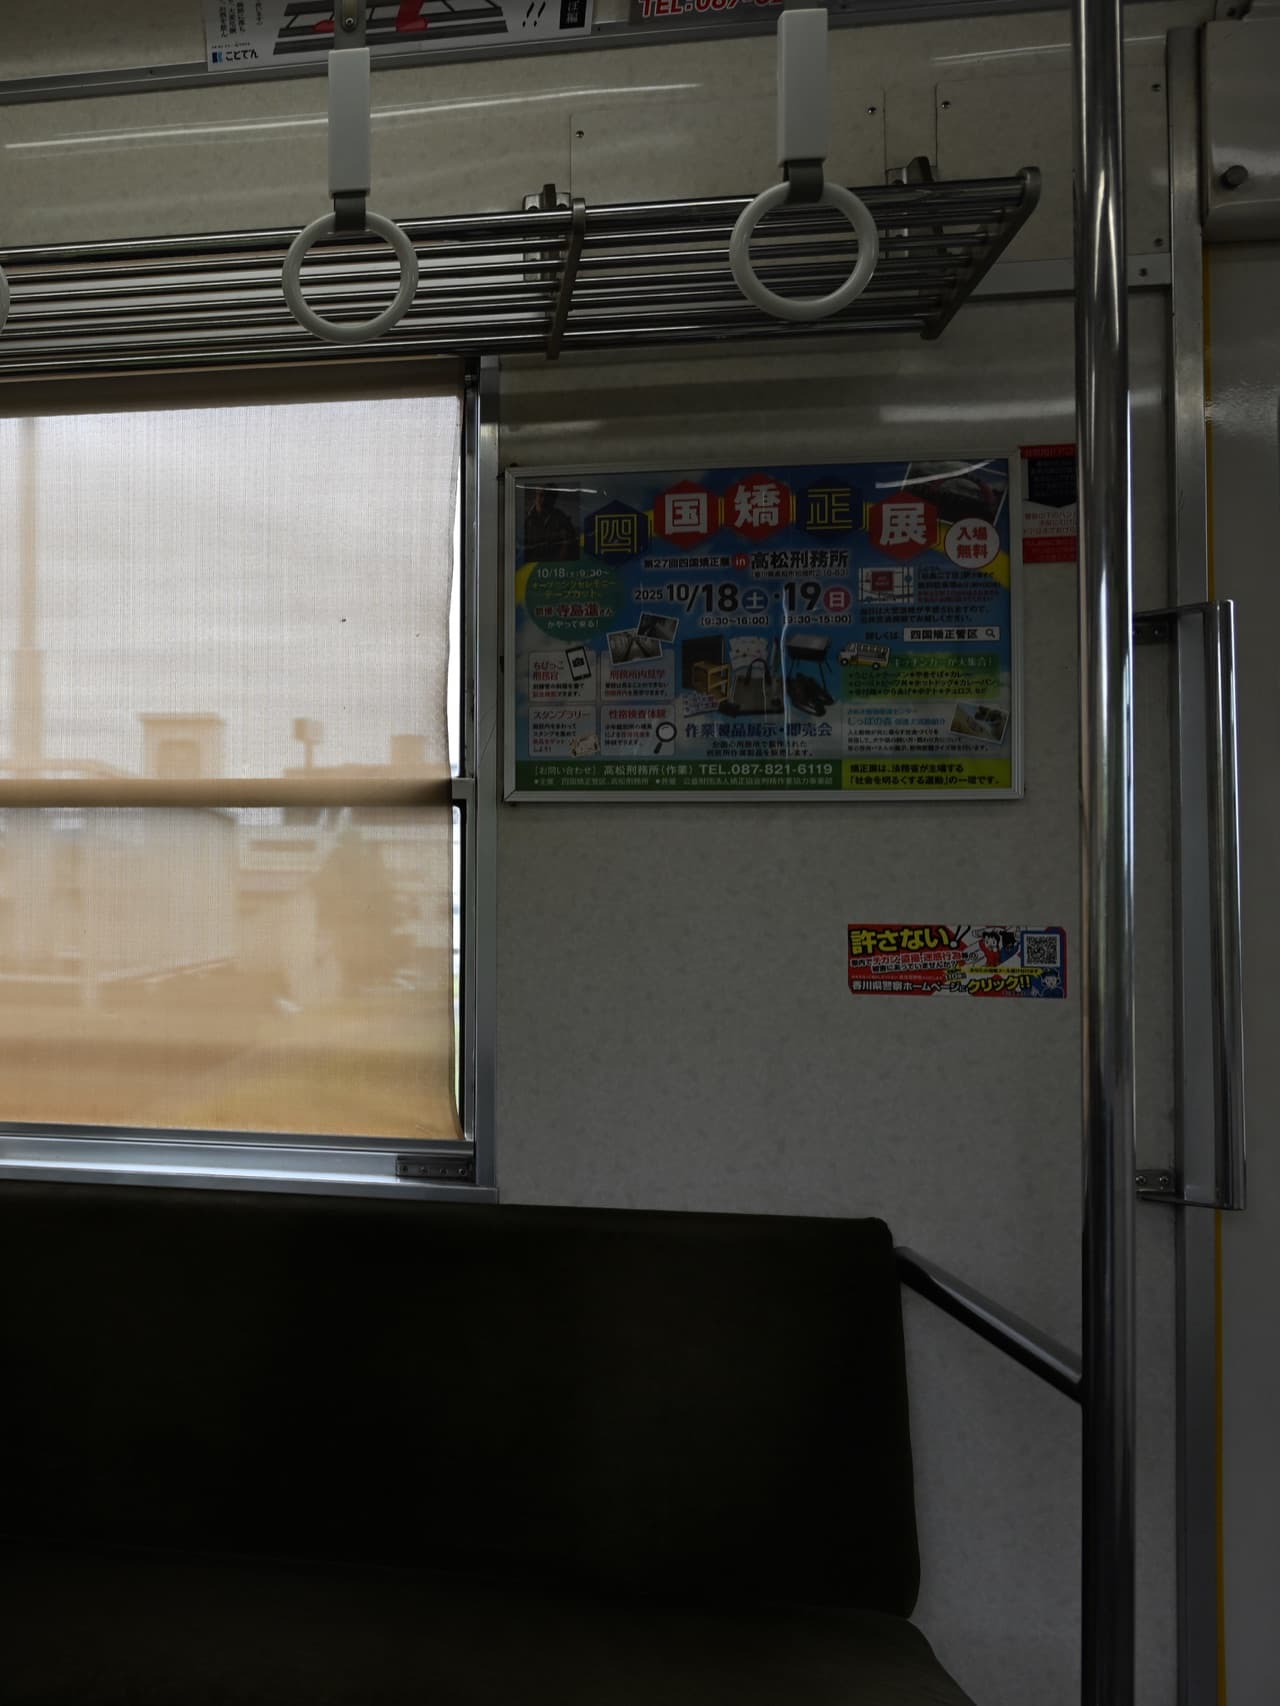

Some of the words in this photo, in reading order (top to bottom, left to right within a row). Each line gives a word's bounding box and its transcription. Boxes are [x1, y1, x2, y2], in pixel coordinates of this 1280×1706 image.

[226, 49, 259, 61] ことでん
[595, 483, 928, 556] 四国矯正展
[736, 557, 746, 568] in
[751, 551, 849, 569] 高松刑務所
[634, 590, 663, 601] 2025
[698, 763, 833, 776] TEL.087-821-6119
